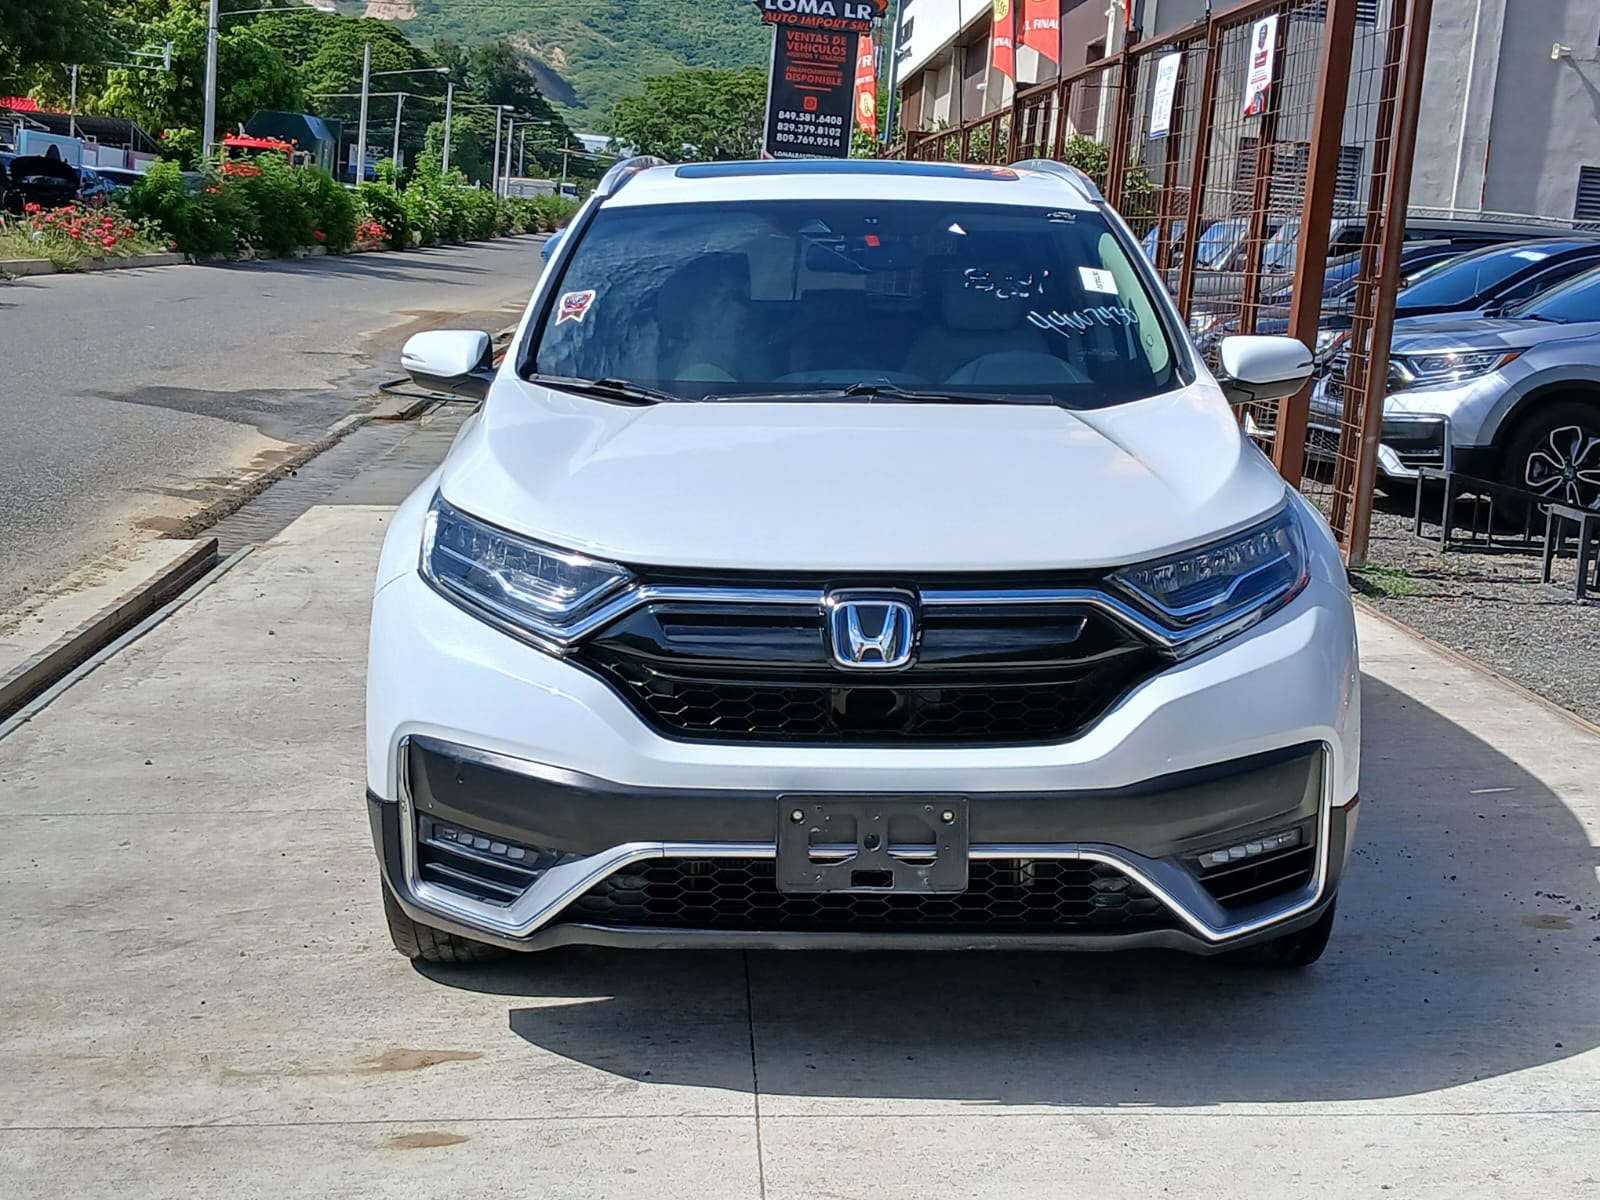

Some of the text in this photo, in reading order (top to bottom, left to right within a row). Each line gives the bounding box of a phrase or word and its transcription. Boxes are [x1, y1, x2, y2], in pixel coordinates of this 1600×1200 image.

[764, 0, 872, 20] LOMA LR
[763, 12, 871, 31] AUTO IMPORT SRL
[786, 31, 847, 46] VENTAS DE
[786, 41, 847, 56] VEHICULOS
[785, 73, 843, 86] DISPONIBLE
[778, 110, 843, 125] 849.581.6408
[776, 122, 841, 137] 829.379.8102
[776, 133, 840, 147] 809.769.9514
